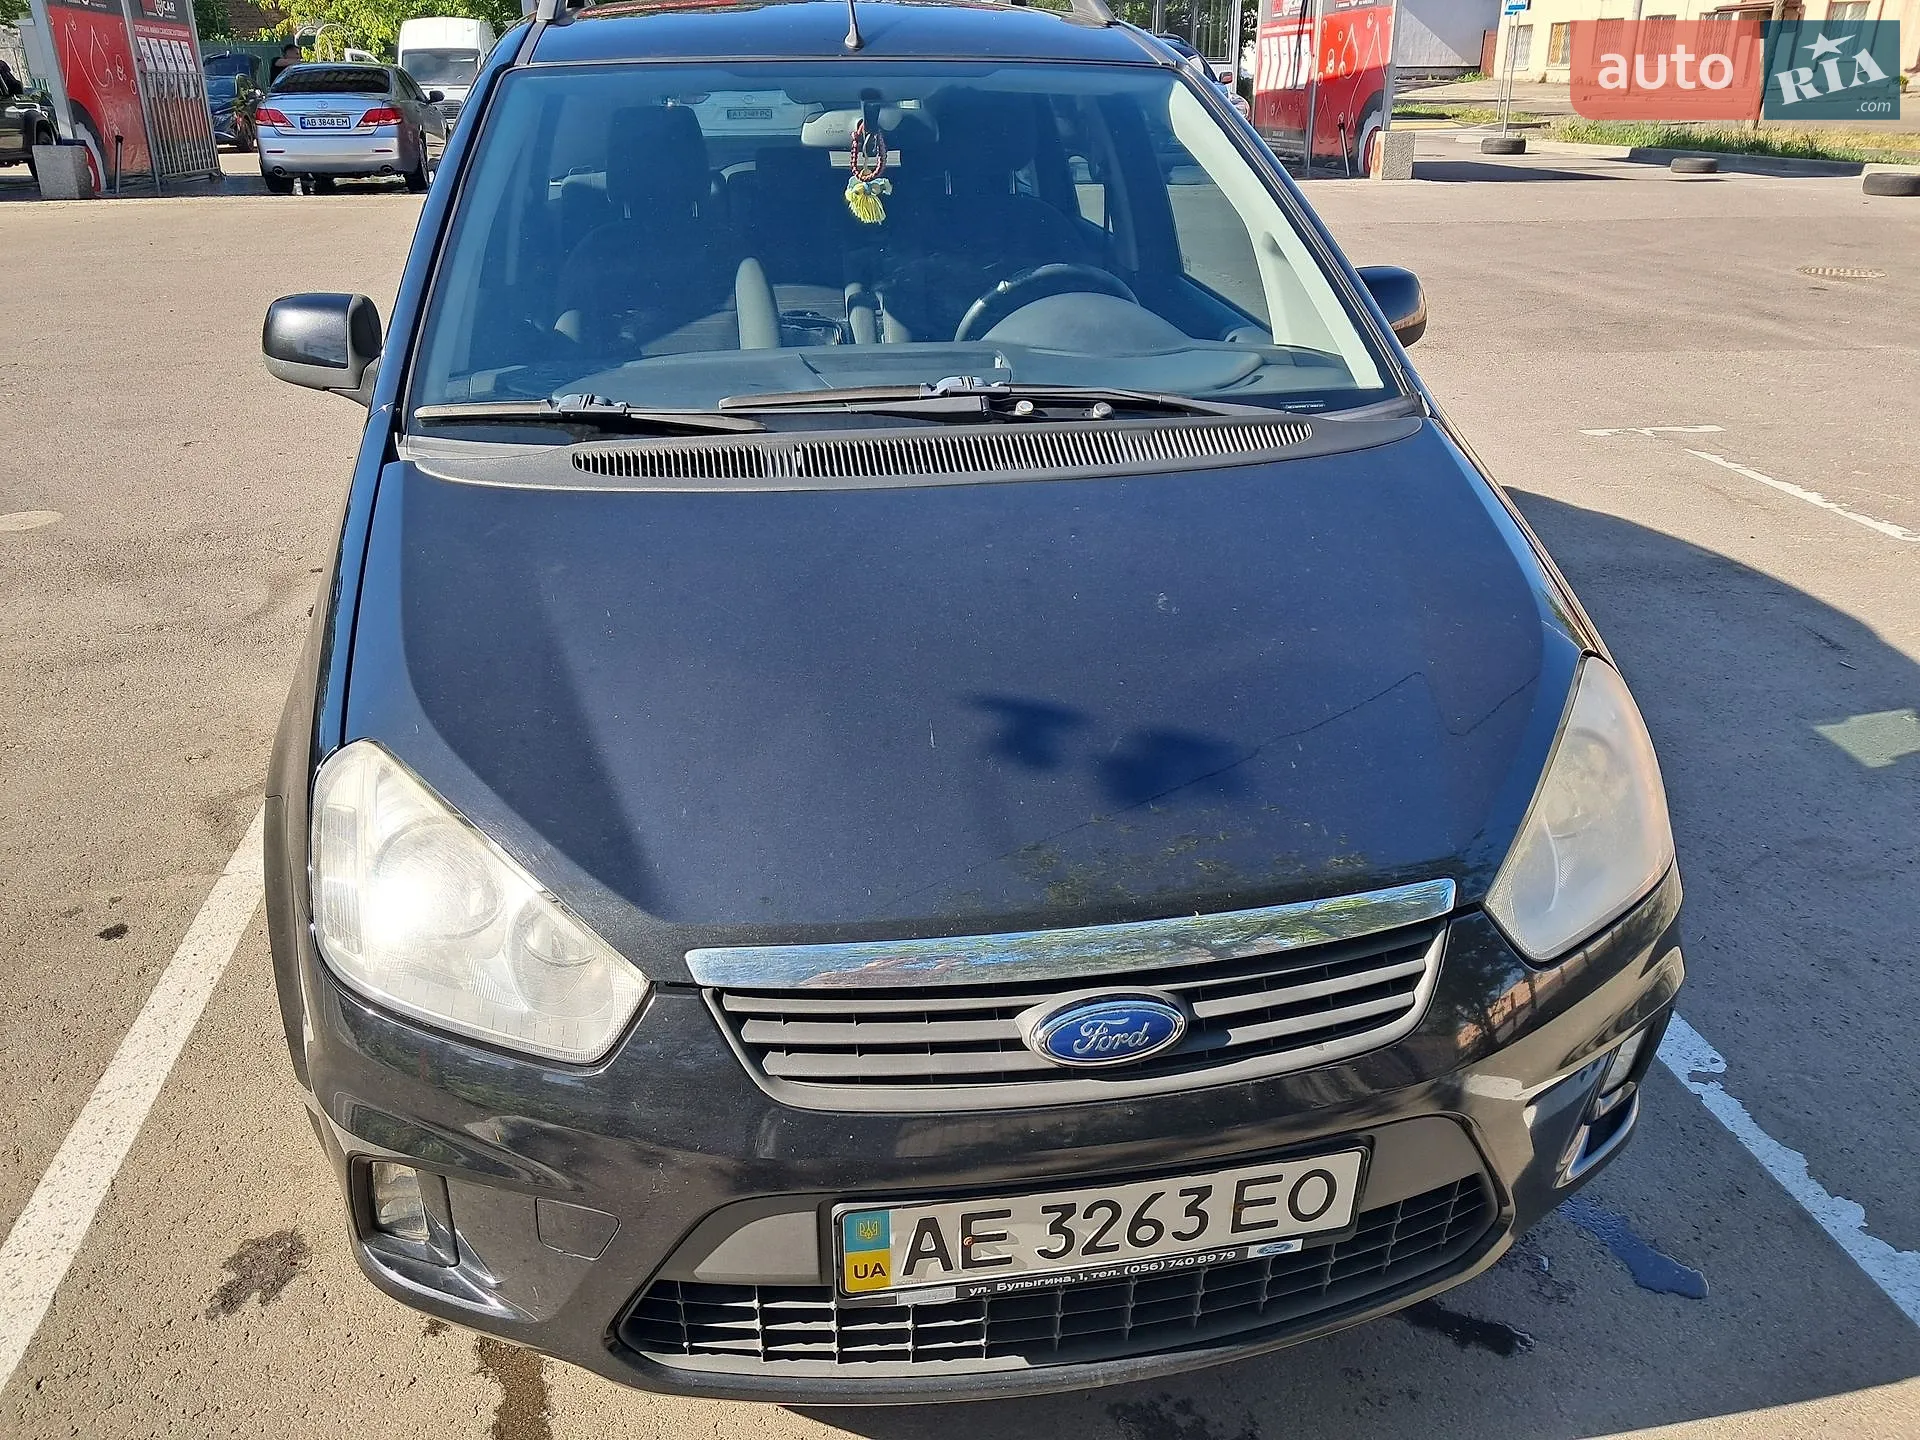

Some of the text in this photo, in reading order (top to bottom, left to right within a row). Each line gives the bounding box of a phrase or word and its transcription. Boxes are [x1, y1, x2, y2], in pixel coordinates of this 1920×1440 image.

[306, 117, 348, 126] AB 3848 EM
[1073, 1017, 1150, 1054] Ford
[902, 1168, 1338, 1277] AE 3263 EO
[854, 1262, 886, 1279] UA
[969, 1250, 1237, 1297] ул. Булыгина, 1, тел. (056) 740 89 79
